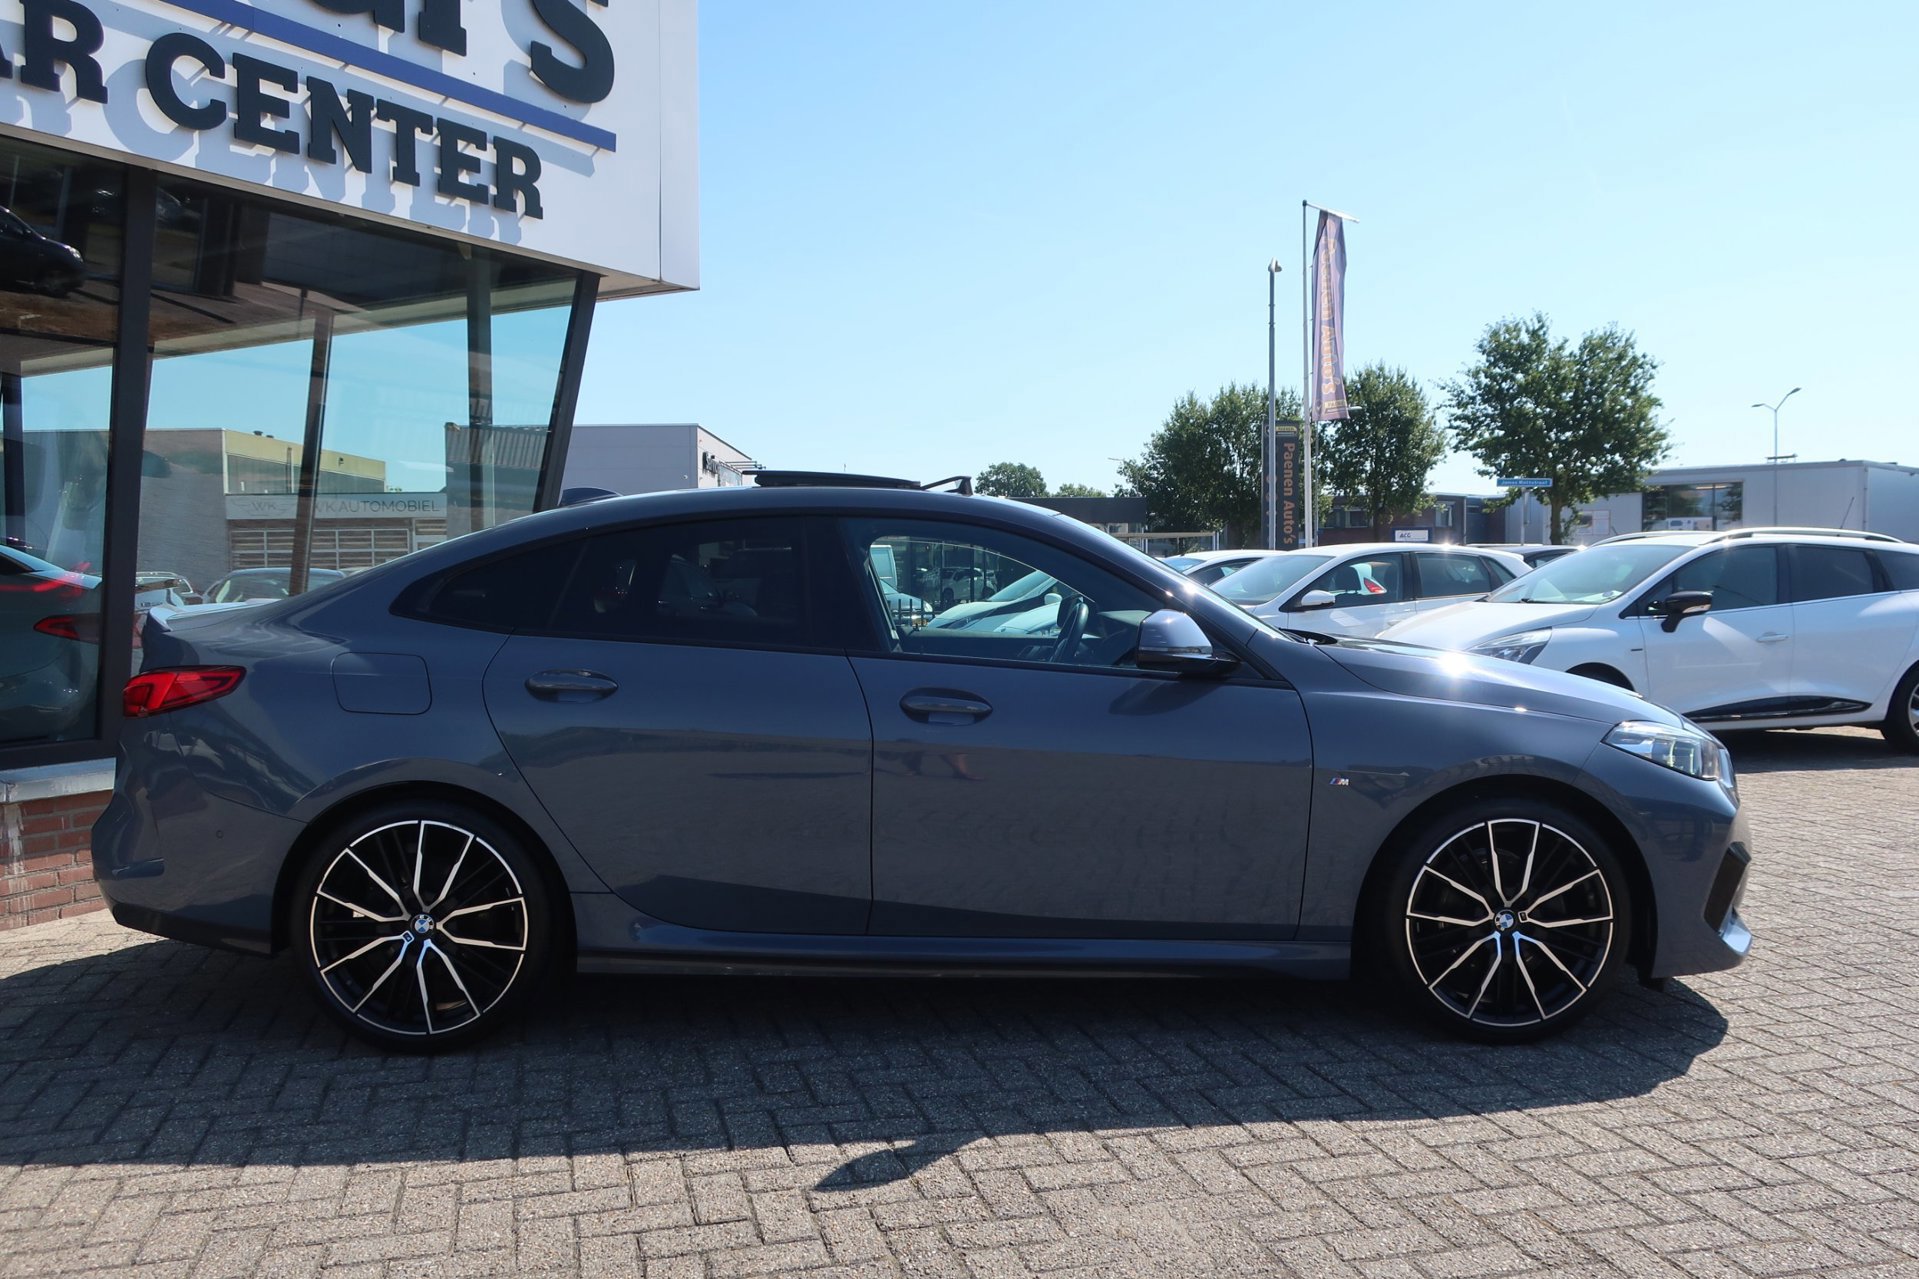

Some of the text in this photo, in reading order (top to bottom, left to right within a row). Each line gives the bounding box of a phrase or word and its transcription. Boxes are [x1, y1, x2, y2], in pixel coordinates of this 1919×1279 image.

[0, 0, 108, 104] R
[145, 32, 543, 219] CENTER
[1283, 442, 1296, 497] Paenen
[338, 500, 440, 512] AUTOMOBIEL
[1283, 500, 1297, 545] Auto's
